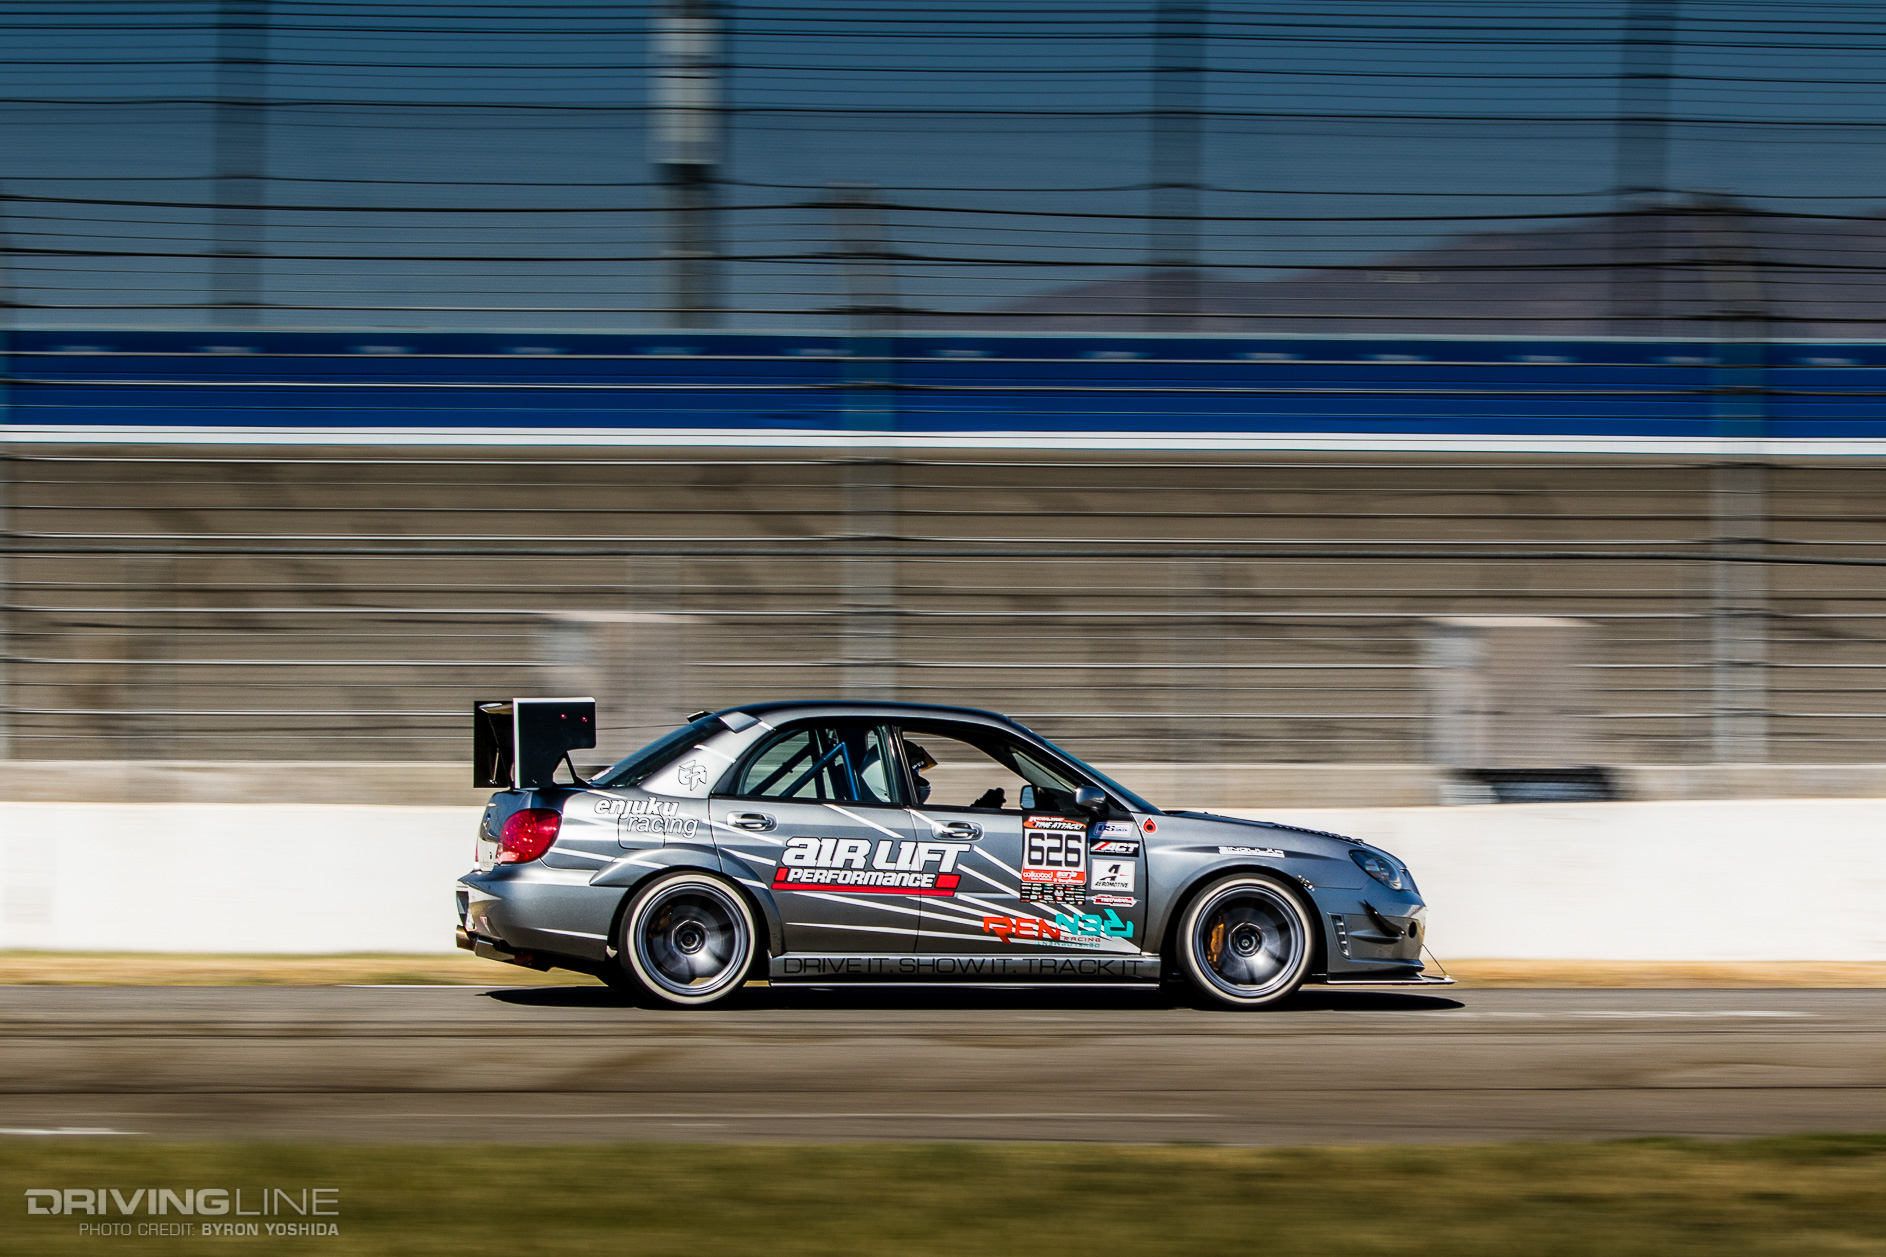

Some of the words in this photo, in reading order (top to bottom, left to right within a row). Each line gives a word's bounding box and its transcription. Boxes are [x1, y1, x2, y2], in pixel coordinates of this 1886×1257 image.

[594, 797, 680, 819] enjuku
[626, 817, 699, 839] racing
[871, 839, 972, 873] LIFT
[1027, 832, 1082, 868] 626
[1099, 841, 1139, 853] ACT
[1063, 935, 1101, 943] RACING
[783, 957, 862, 974] DRIVE
[898, 957, 986, 974] SHOW
[1022, 958, 1116, 976] TRACK
[1121, 959, 1144, 976] IT
